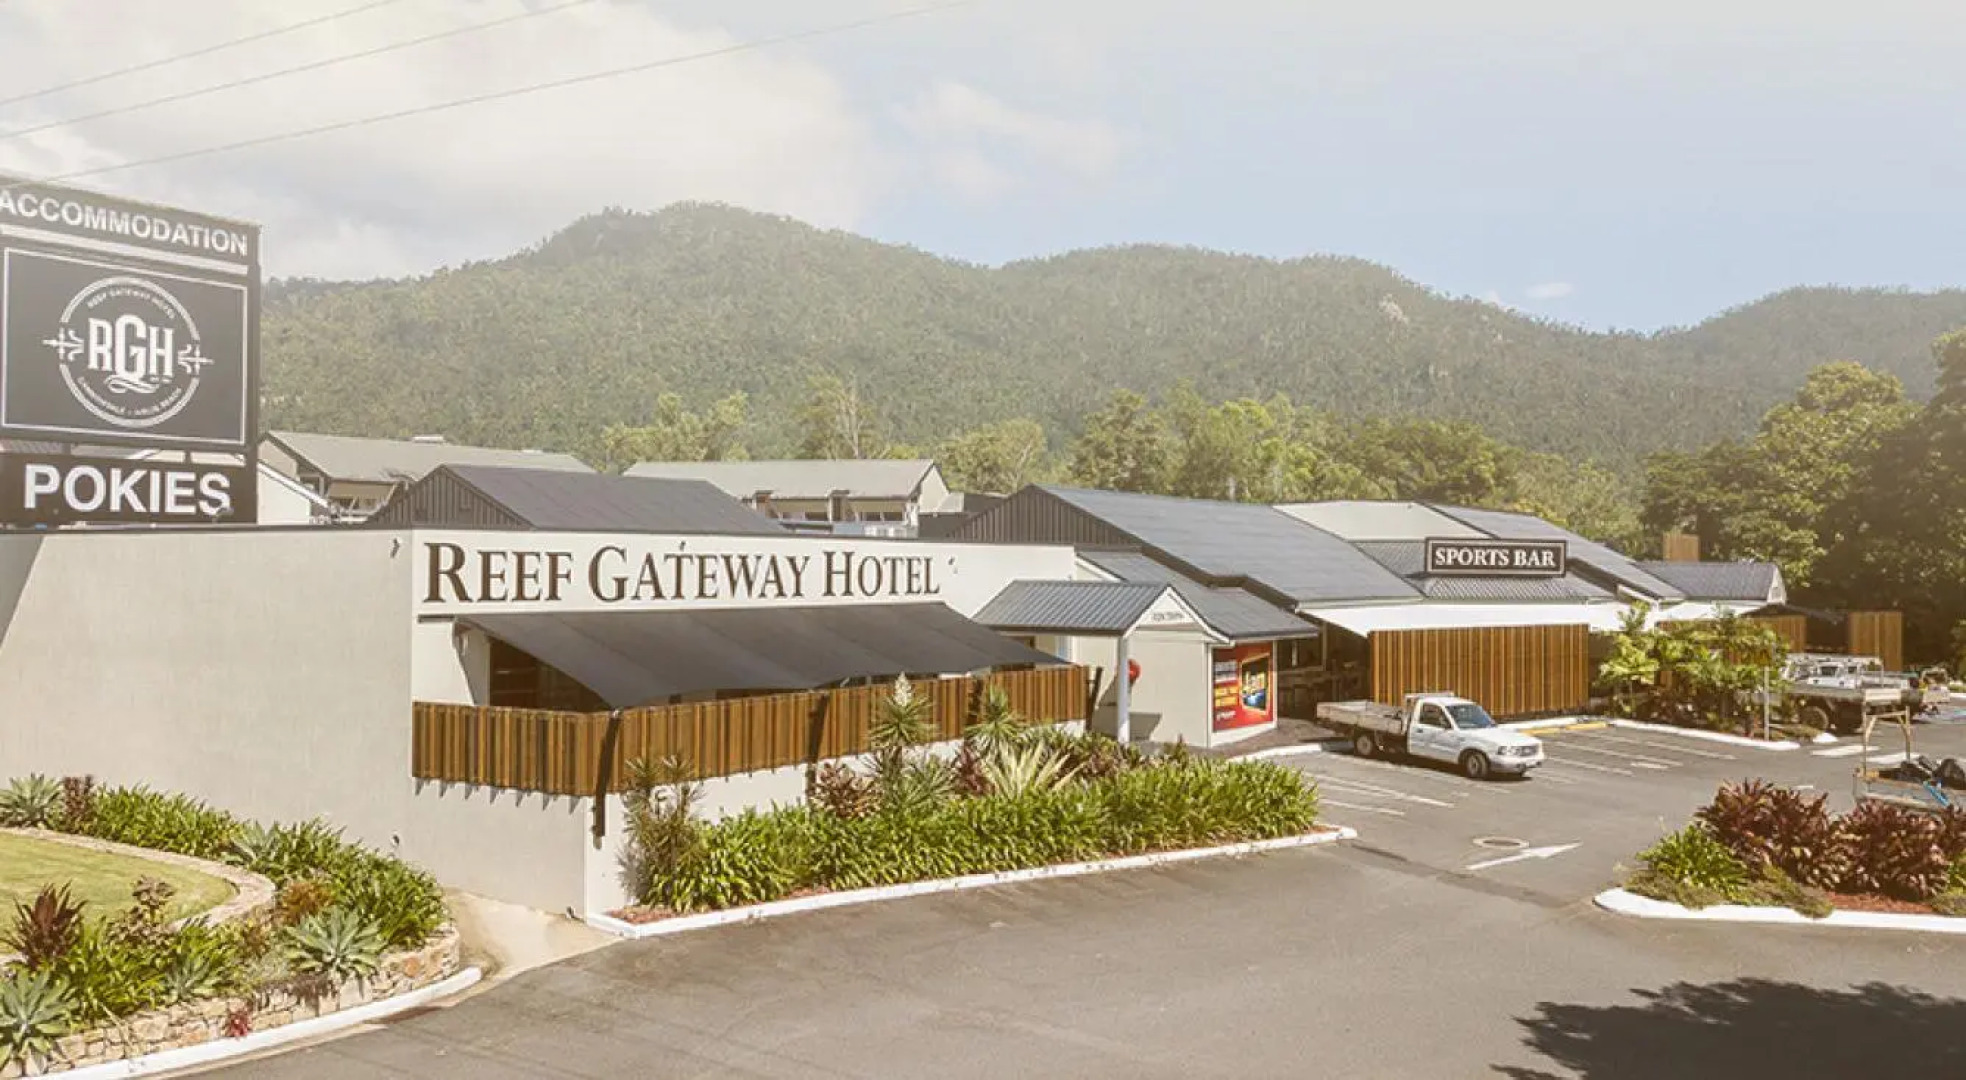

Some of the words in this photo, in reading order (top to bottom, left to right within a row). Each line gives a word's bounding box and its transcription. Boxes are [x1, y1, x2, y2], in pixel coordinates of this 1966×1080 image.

[0, 190, 248, 256] ACCOMMODATION
[88, 314, 175, 384] RGH
[24, 463, 231, 515] POKIES
[423, 542, 574, 603] REEF
[588, 545, 811, 601] GATEWAY
[822, 551, 940, 597] HOTEL
[1435, 547, 1509, 566] SPORTS
[1513, 549, 1556, 566] BAR
